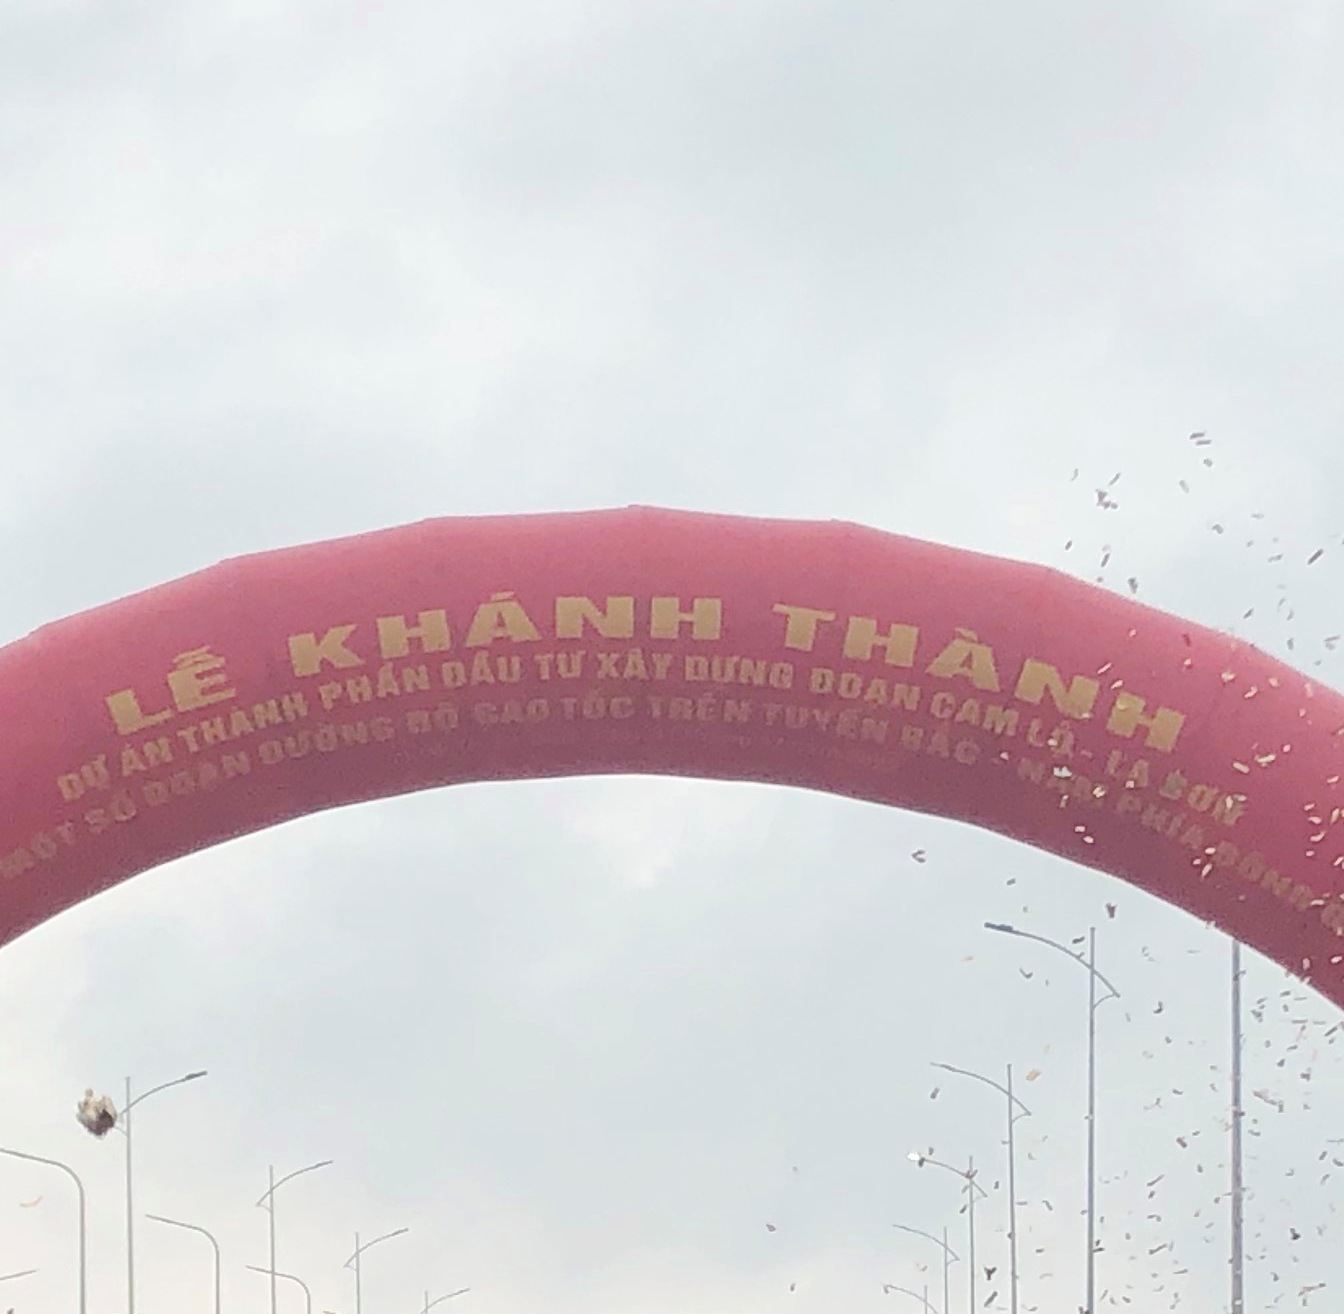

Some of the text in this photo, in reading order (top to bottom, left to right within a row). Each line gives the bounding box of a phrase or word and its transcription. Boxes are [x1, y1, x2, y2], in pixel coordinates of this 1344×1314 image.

[288, 592, 722, 677] KHÁNH
[773, 604, 1186, 752] THÀNH
[929, 692, 1020, 736] CAM
